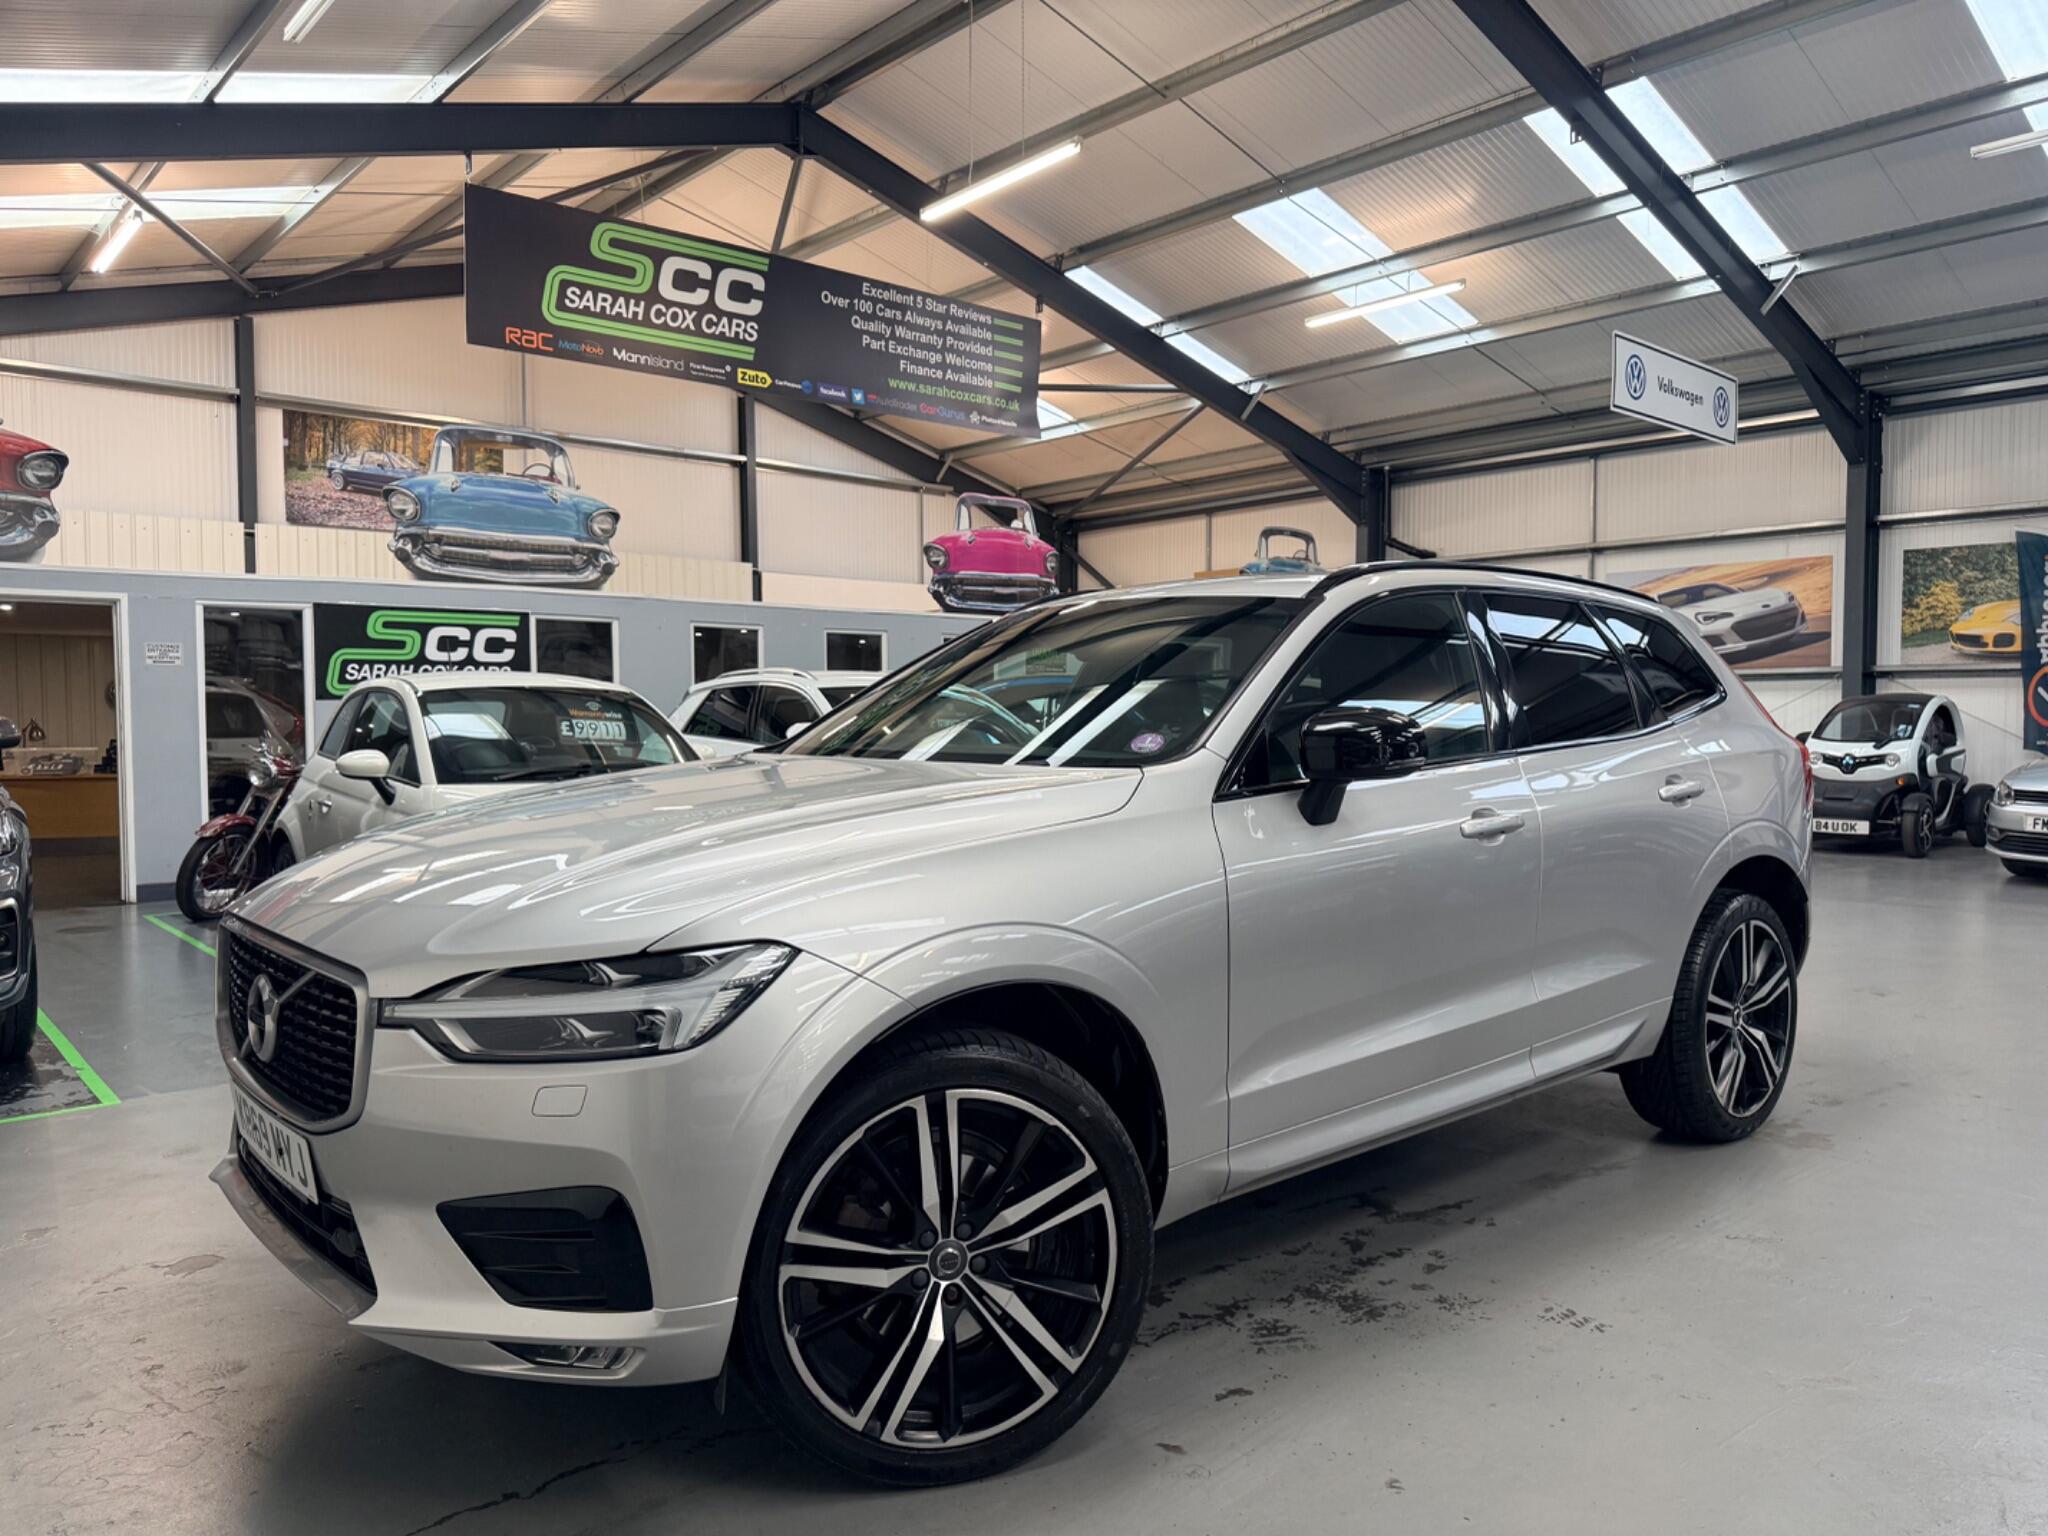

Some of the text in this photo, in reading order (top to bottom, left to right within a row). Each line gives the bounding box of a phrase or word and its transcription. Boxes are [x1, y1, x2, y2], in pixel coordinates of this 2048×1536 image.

[564, 286, 759, 342] SARAH COX CARS
[821, 290, 992, 341] Over 100 Cars Always Available
[862, 282, 992, 325] Excellent 5 Star Reviews
[851, 315, 993, 357] Quality Warranty Provided
[862, 335, 993, 372] Part Exchange Welcome
[740, 371, 767, 385] Zuto
[900, 360, 993, 388] Finance Available
[1657, 376, 1704, 406] Volkswagen
[888, 377, 1021, 413] www.sarahcoxcars.co.uk
